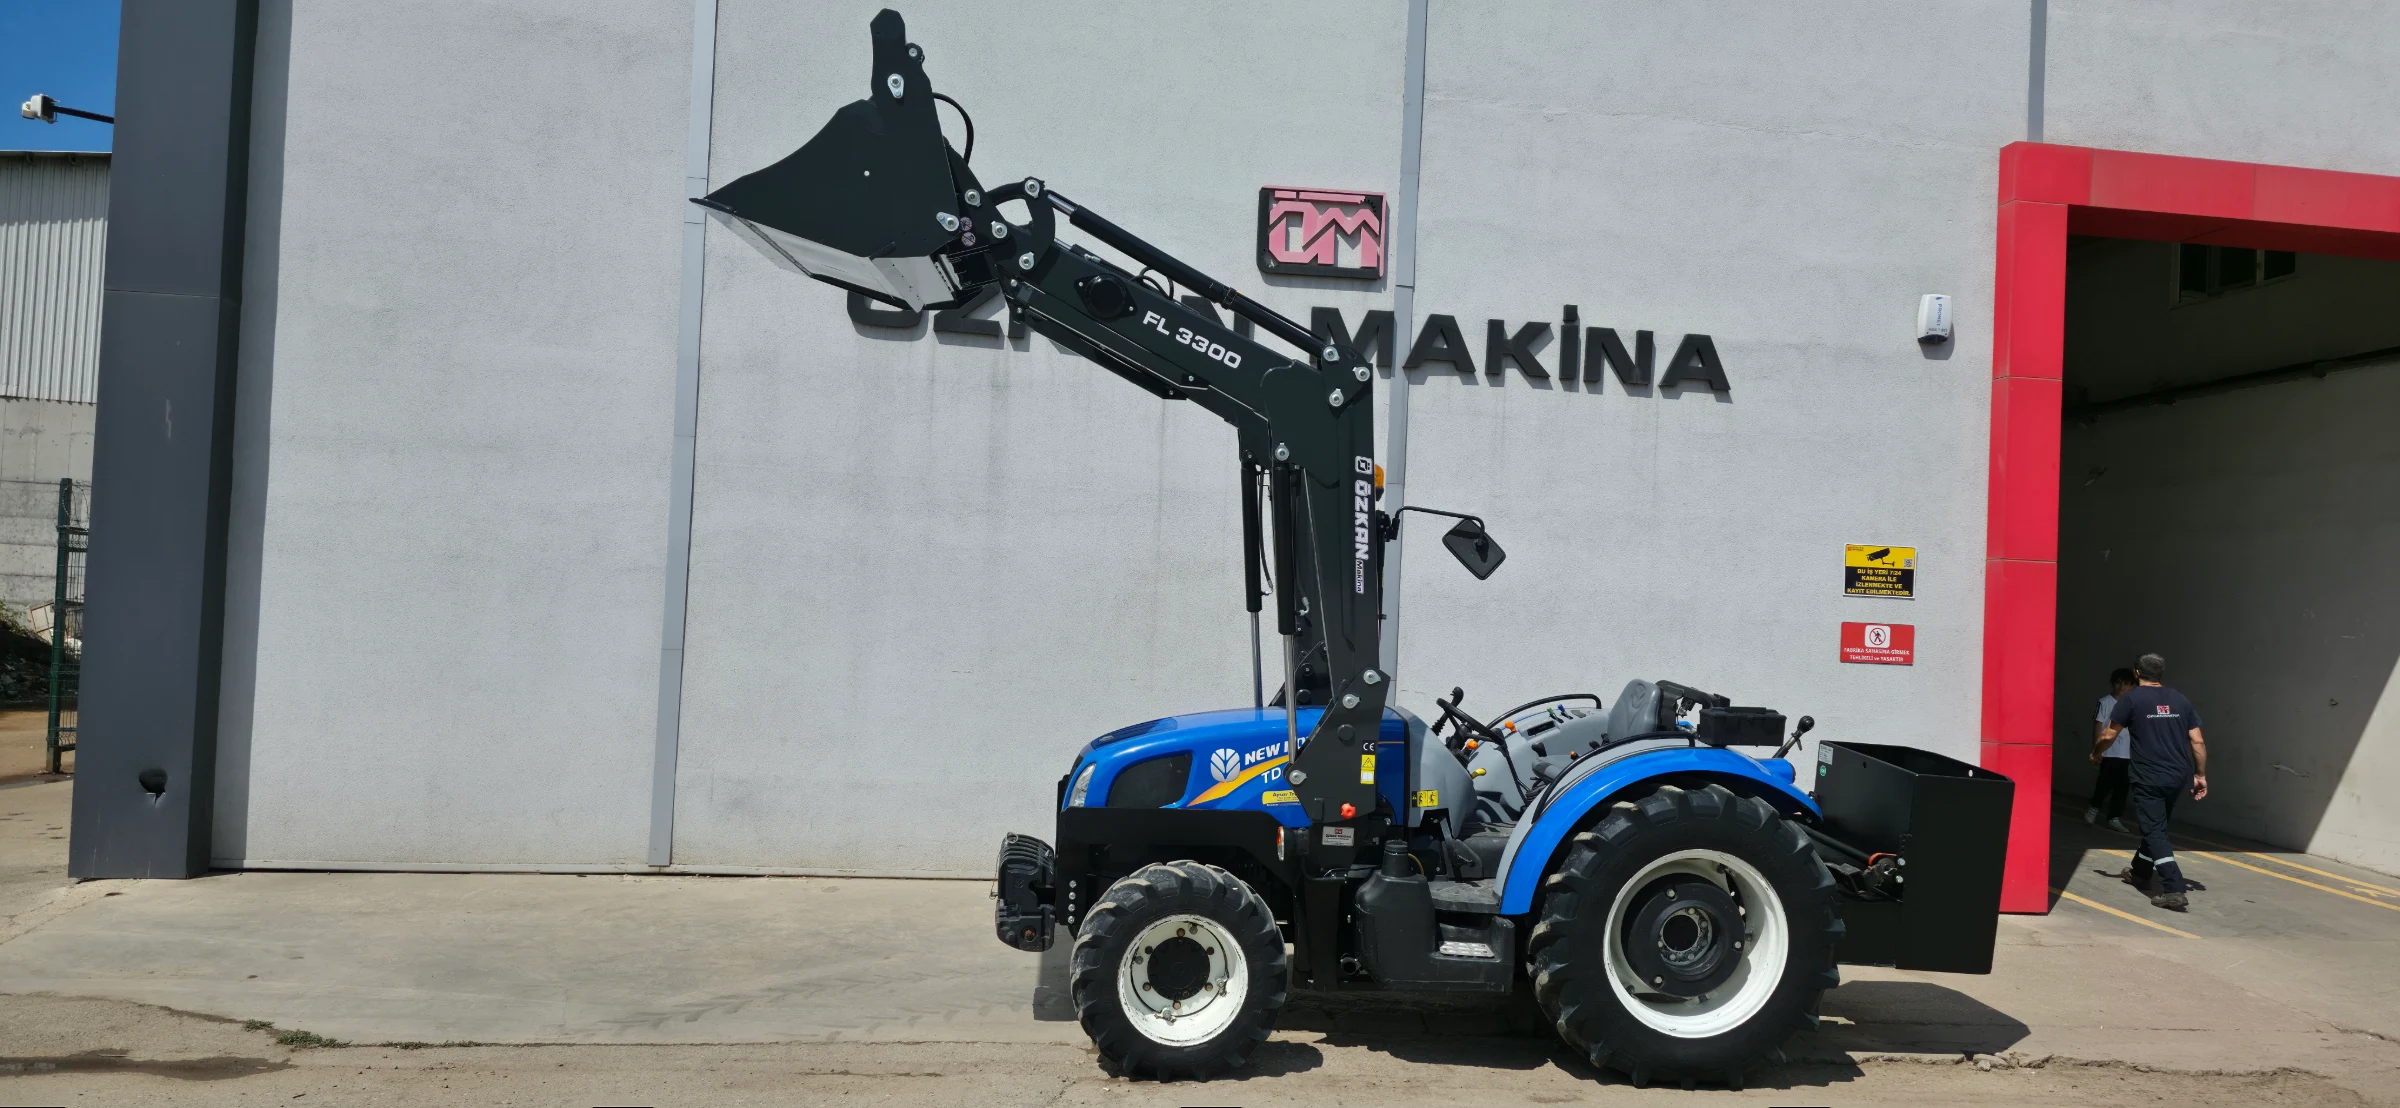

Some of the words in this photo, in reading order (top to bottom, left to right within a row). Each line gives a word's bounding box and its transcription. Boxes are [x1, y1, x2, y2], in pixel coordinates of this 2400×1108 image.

[1142, 310, 1170, 336] FL
[1175, 327, 1242, 369] 3300
[1310, 304, 1732, 392] MAKİNA
[1355, 479, 1371, 560] ÖZKAN
[1355, 560, 1364, 593] Makina
[1245, 742, 1281, 766] NEW
[1261, 767, 1282, 784] TD
